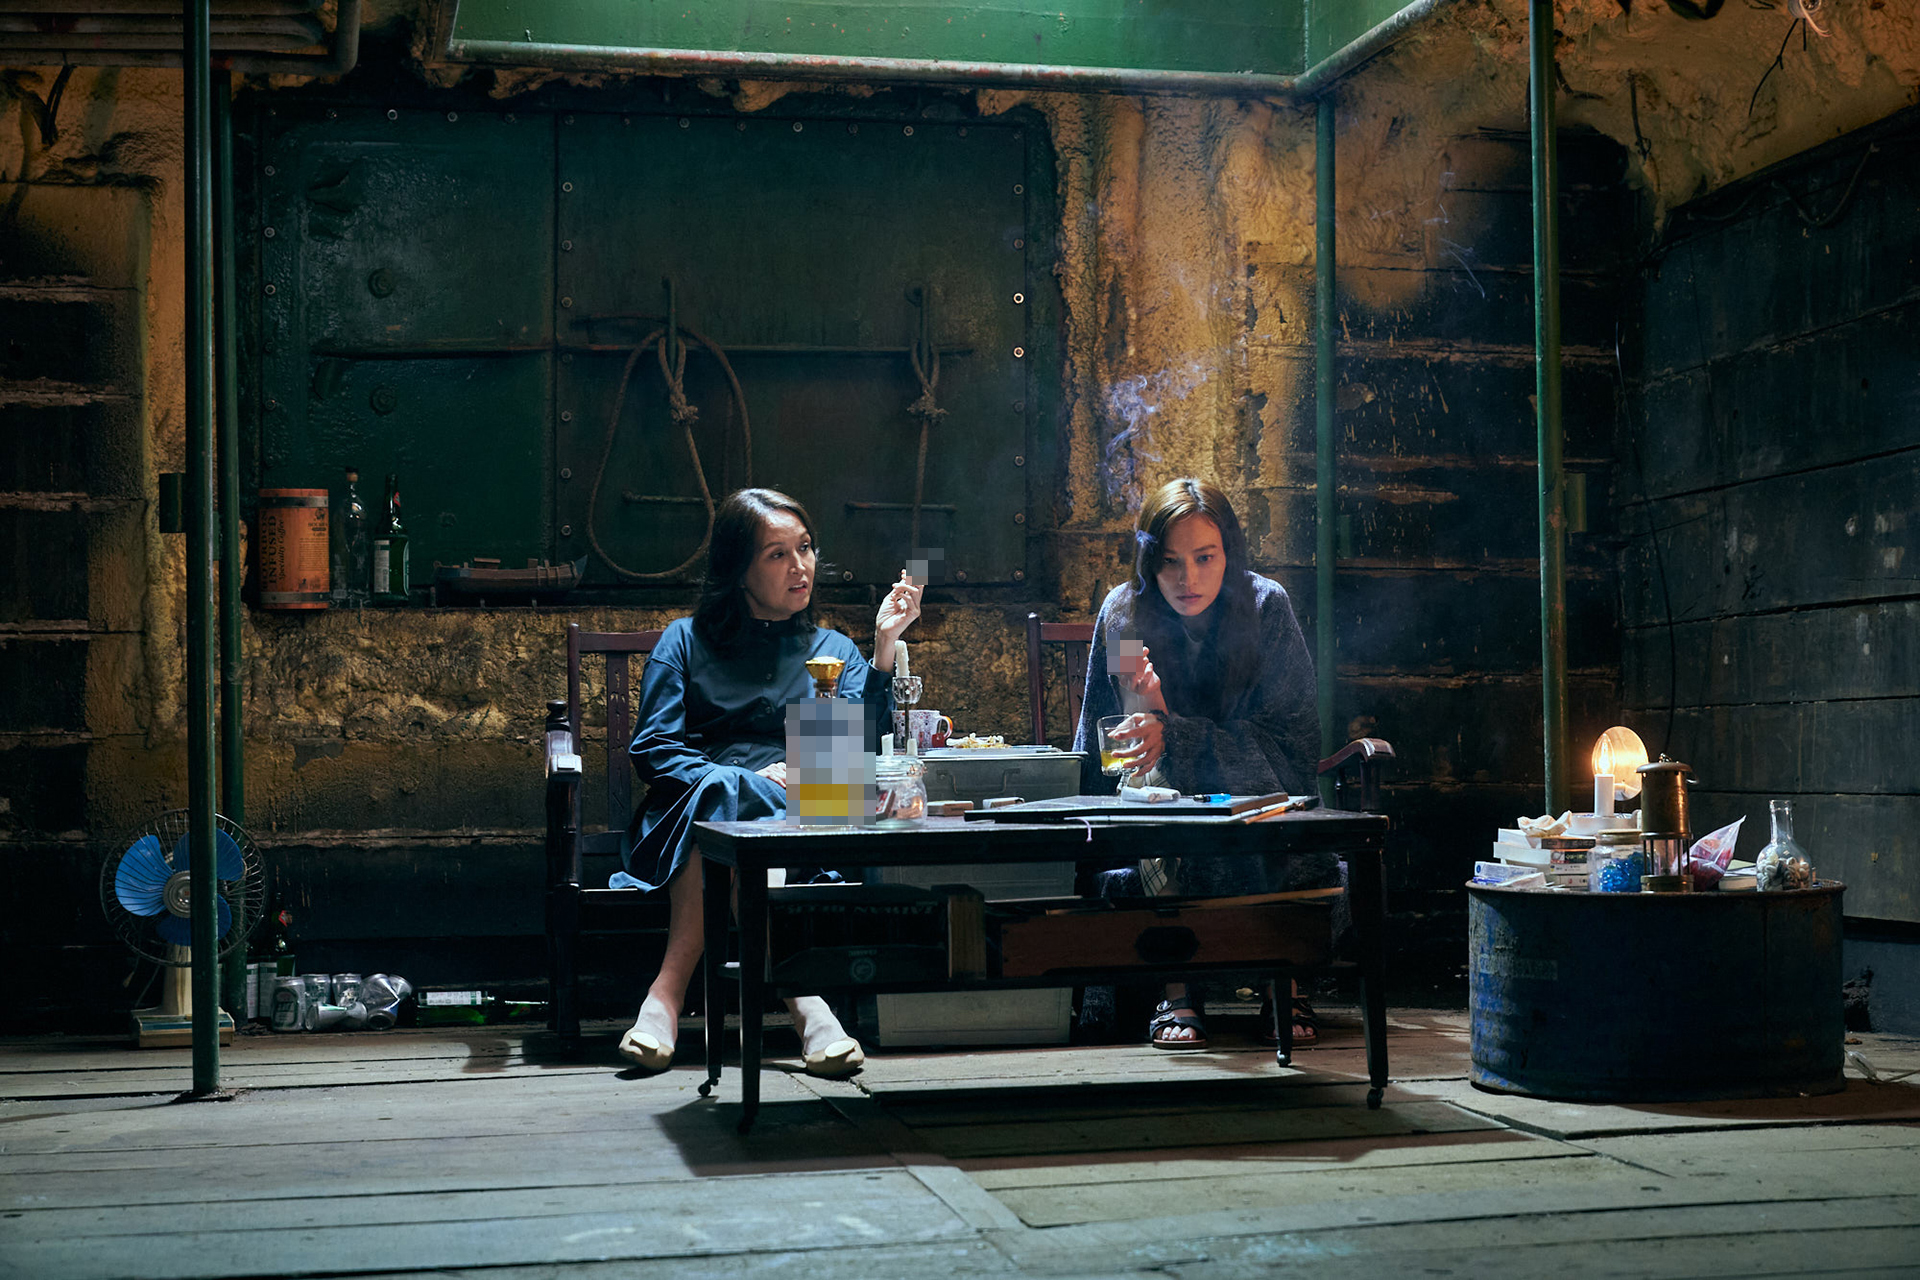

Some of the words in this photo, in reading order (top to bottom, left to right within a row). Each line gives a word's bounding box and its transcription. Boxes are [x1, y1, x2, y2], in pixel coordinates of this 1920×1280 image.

[277, 519, 286, 544] Coffee
[268, 515, 277, 584] INFUSED
[277, 545, 286, 580] Specialty
